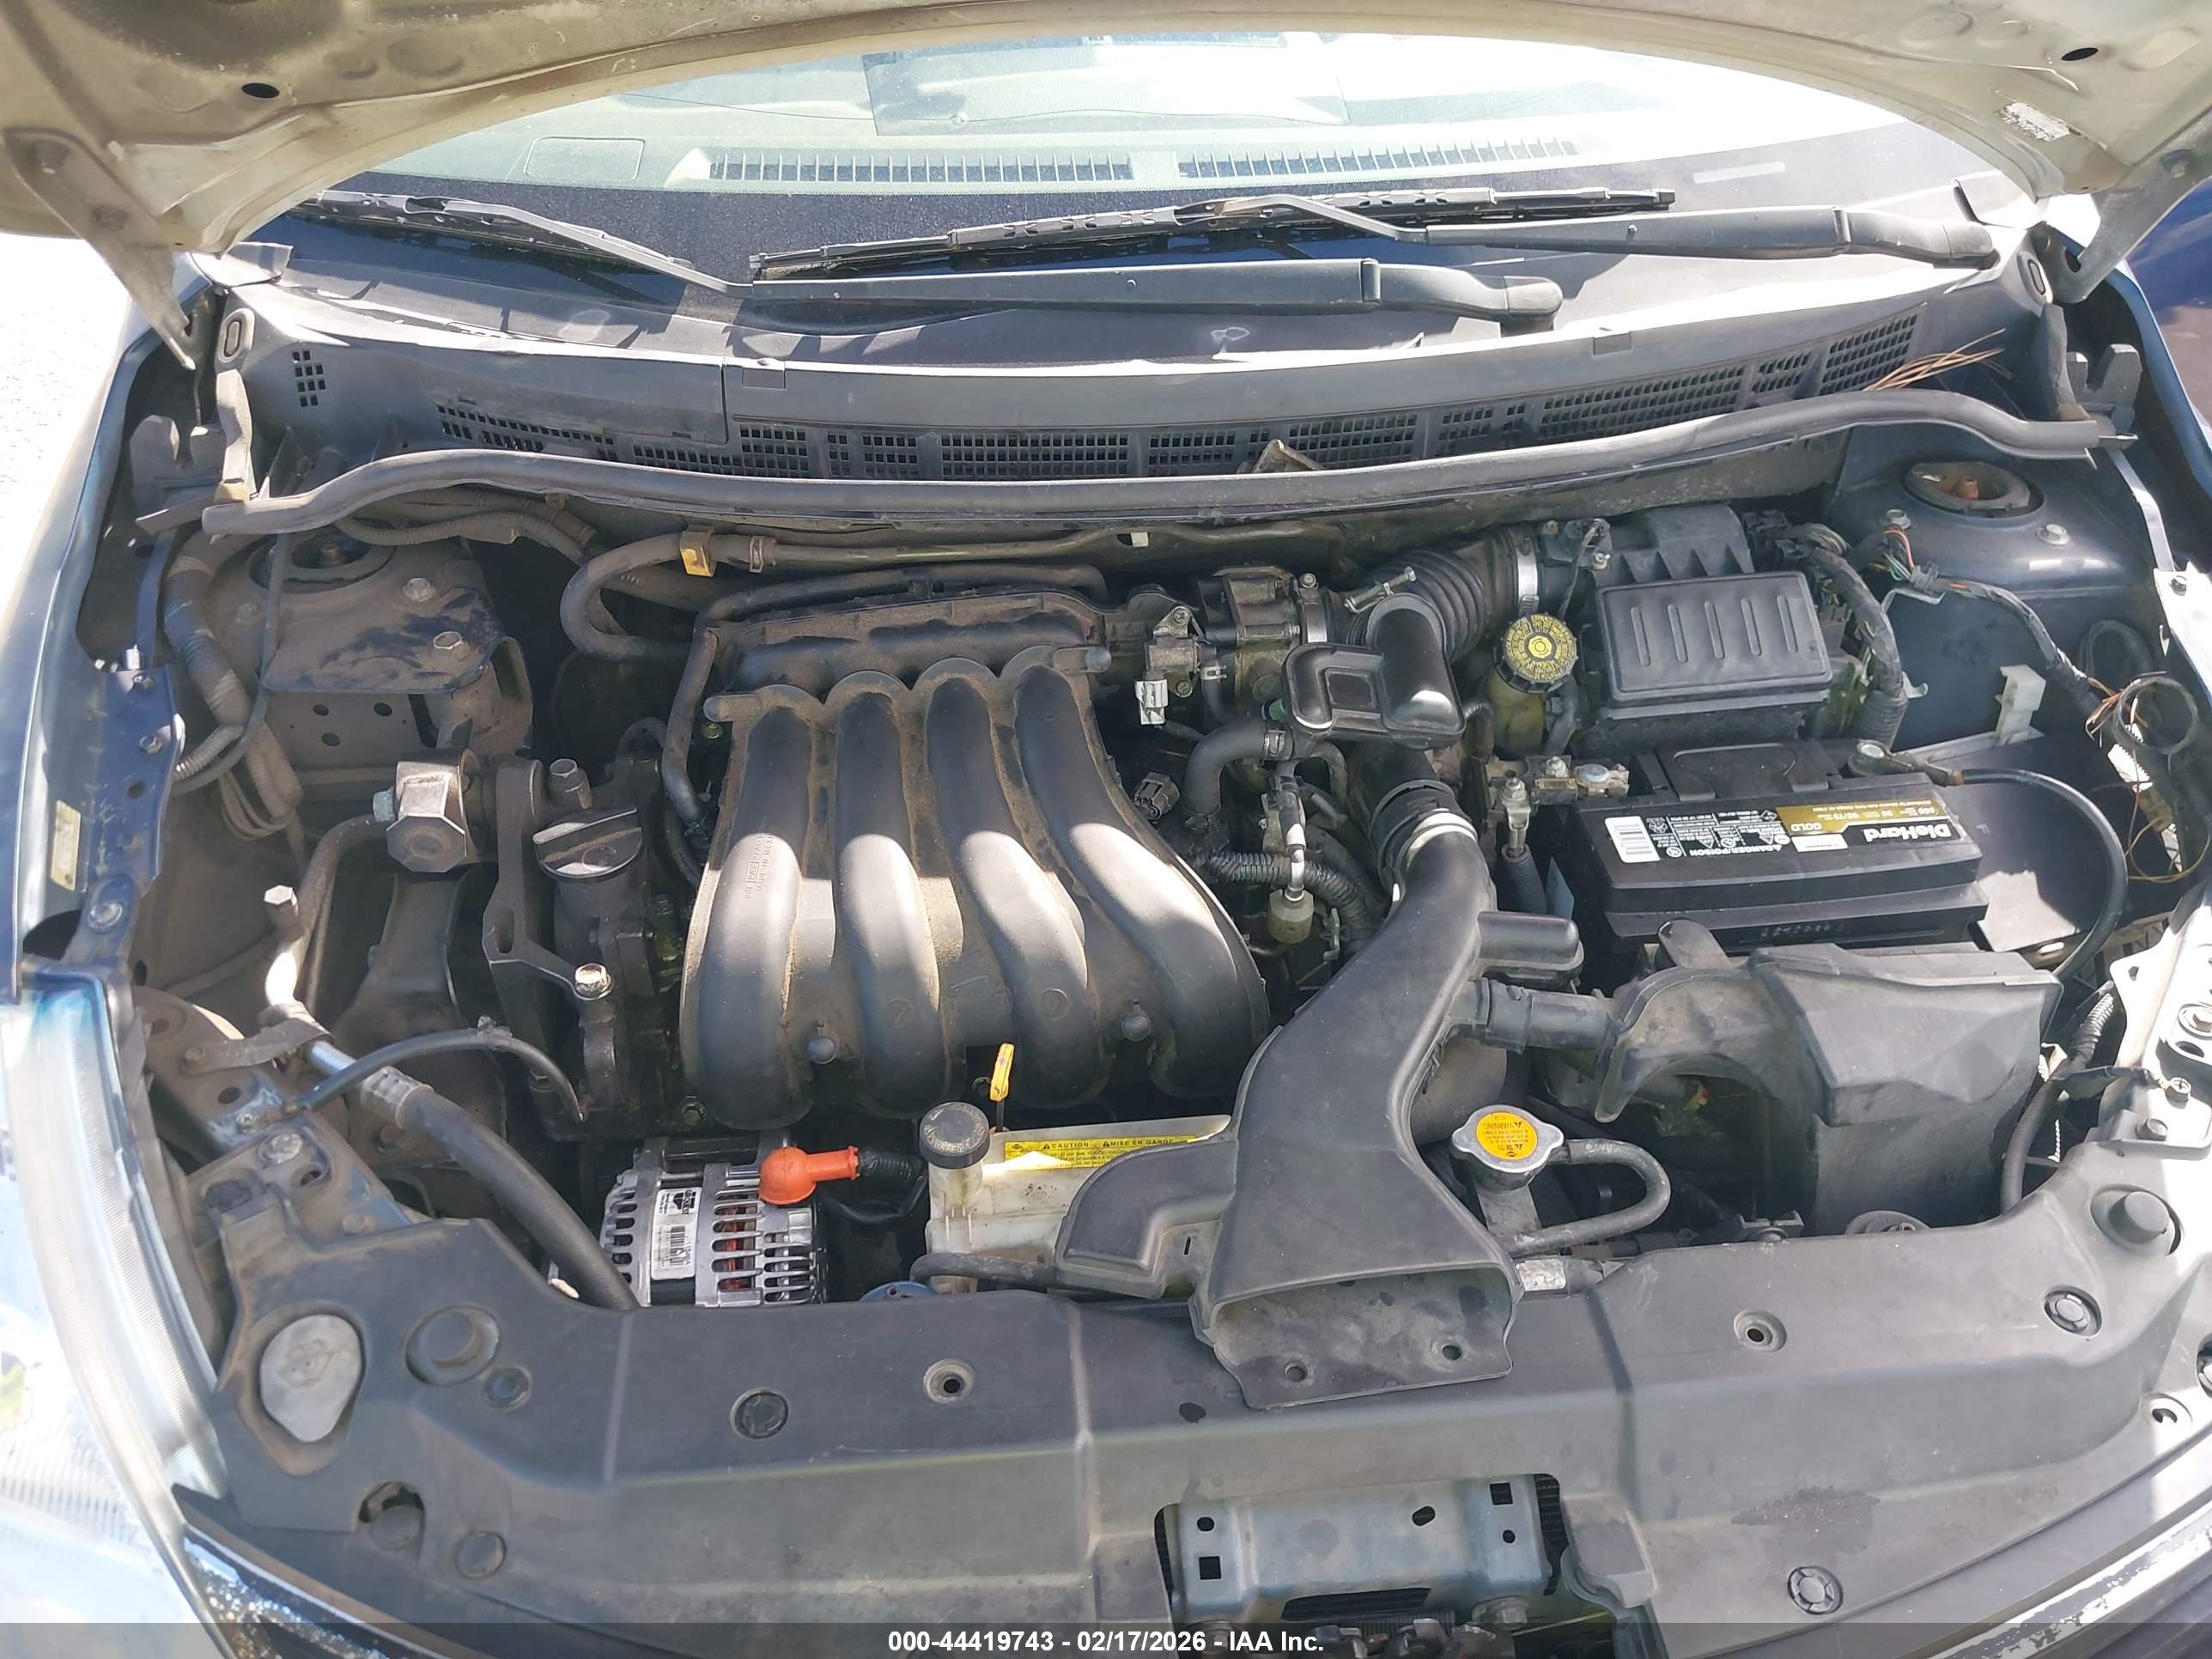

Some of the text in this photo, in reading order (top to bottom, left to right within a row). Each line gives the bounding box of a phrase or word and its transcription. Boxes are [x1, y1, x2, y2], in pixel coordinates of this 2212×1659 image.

[1791, 823, 1822, 832] GOLD
[1863, 823, 1952, 843] DieHard
[1689, 845, 1773, 857] DANGER/POISON
